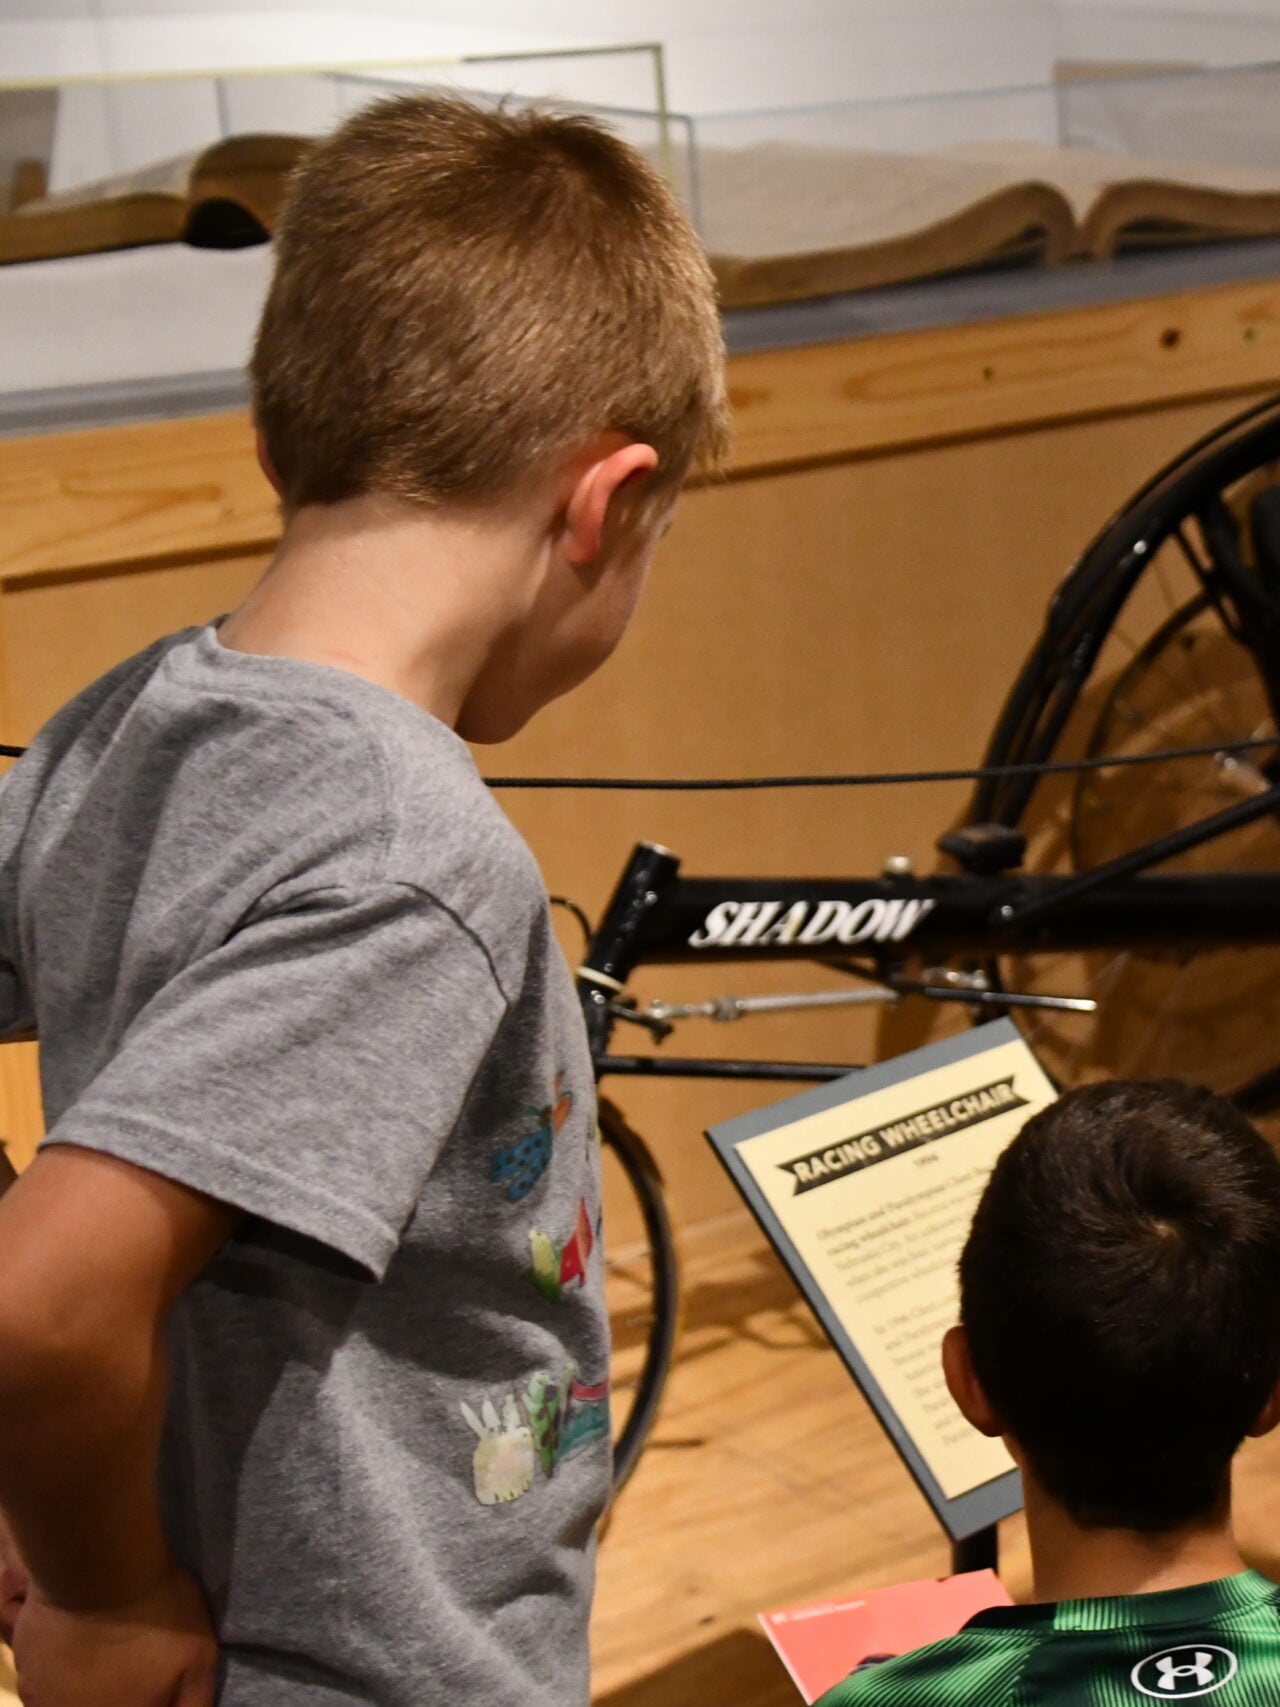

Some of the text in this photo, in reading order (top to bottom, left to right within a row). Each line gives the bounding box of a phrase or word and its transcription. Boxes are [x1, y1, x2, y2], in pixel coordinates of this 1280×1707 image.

[688, 899, 936, 948] SHADOW
[794, 1082, 1018, 1184] RACING WHEELCHAIR
